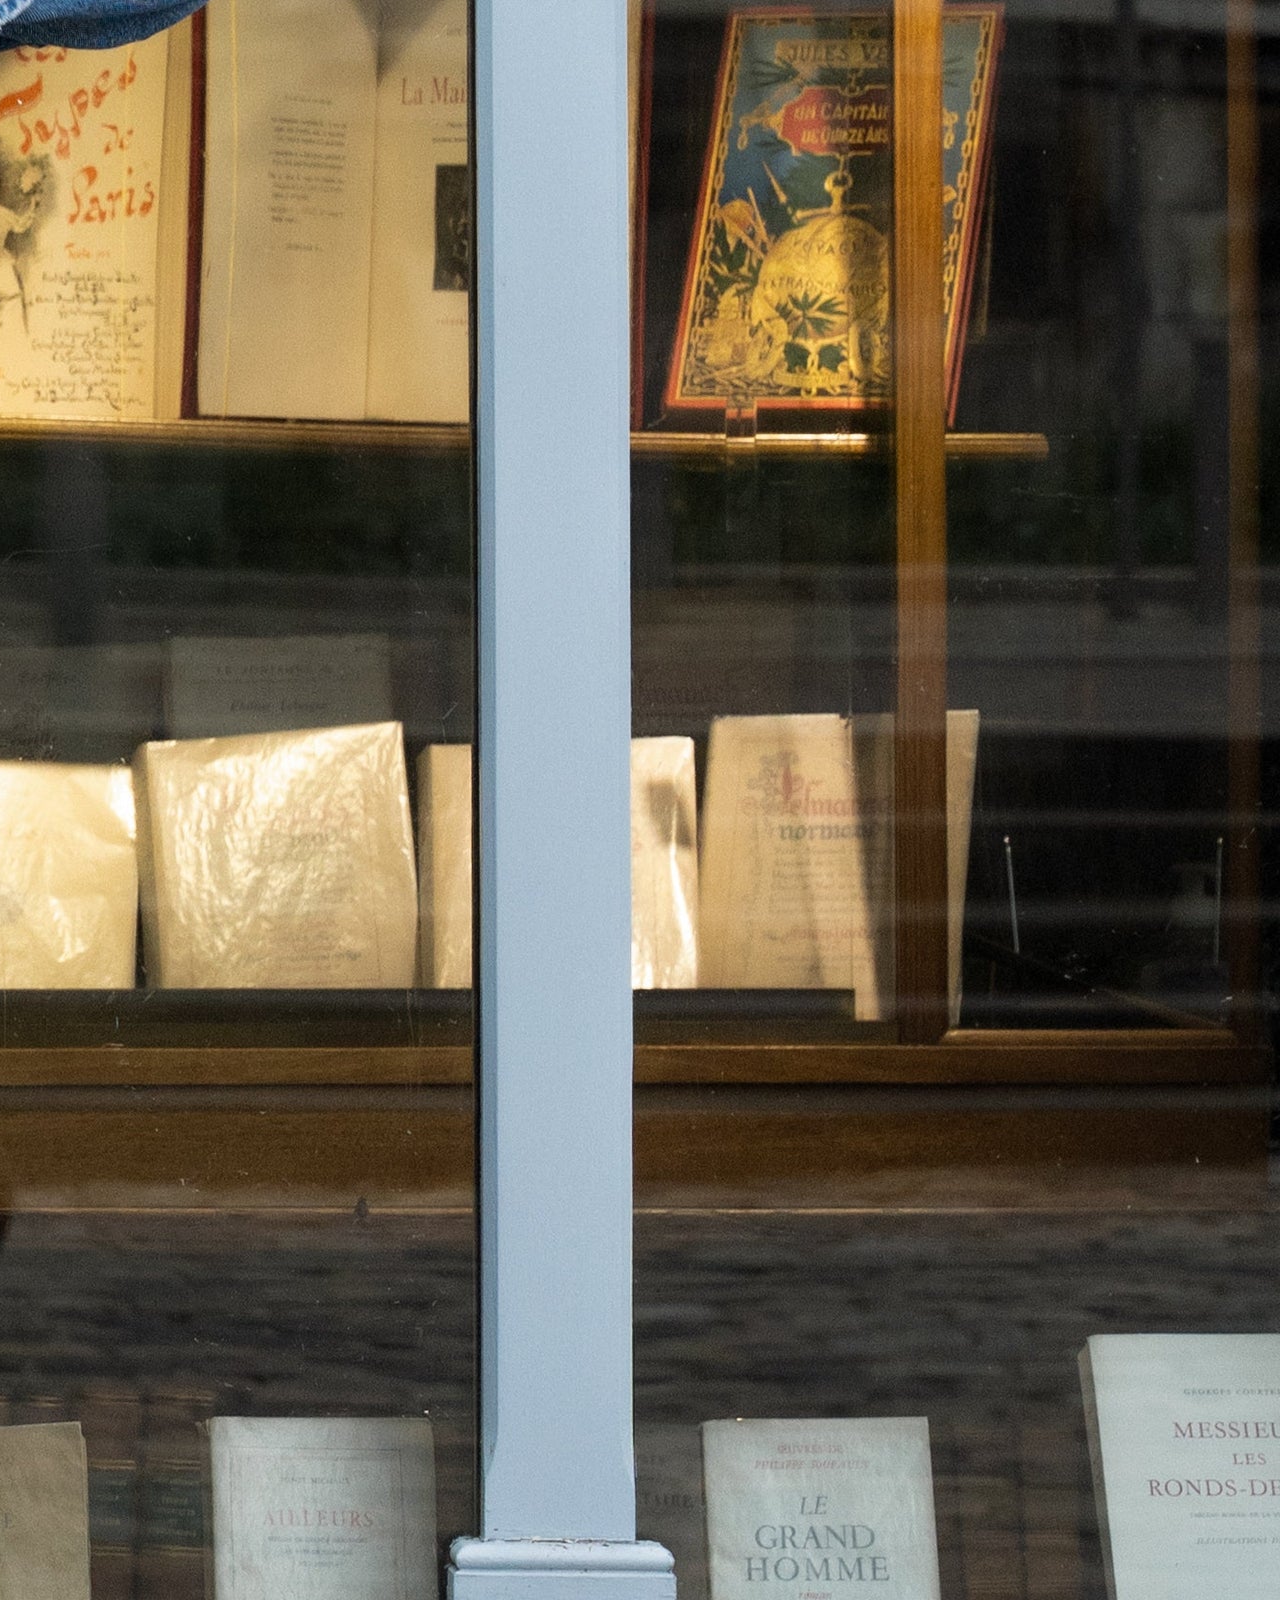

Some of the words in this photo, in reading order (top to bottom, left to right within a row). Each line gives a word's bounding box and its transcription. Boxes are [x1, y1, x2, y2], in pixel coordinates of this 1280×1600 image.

[68, 165, 156, 225] Paris
[1232, 1452, 1267, 1466] LES
[1147, 1478, 1280, 1497] RONDS-DE
[799, 1494, 828, 1516] LE
[262, 1508, 376, 1528] AILLEURS
[754, 1524, 876, 1550] GRAND
[745, 1556, 891, 1582] HOMME
